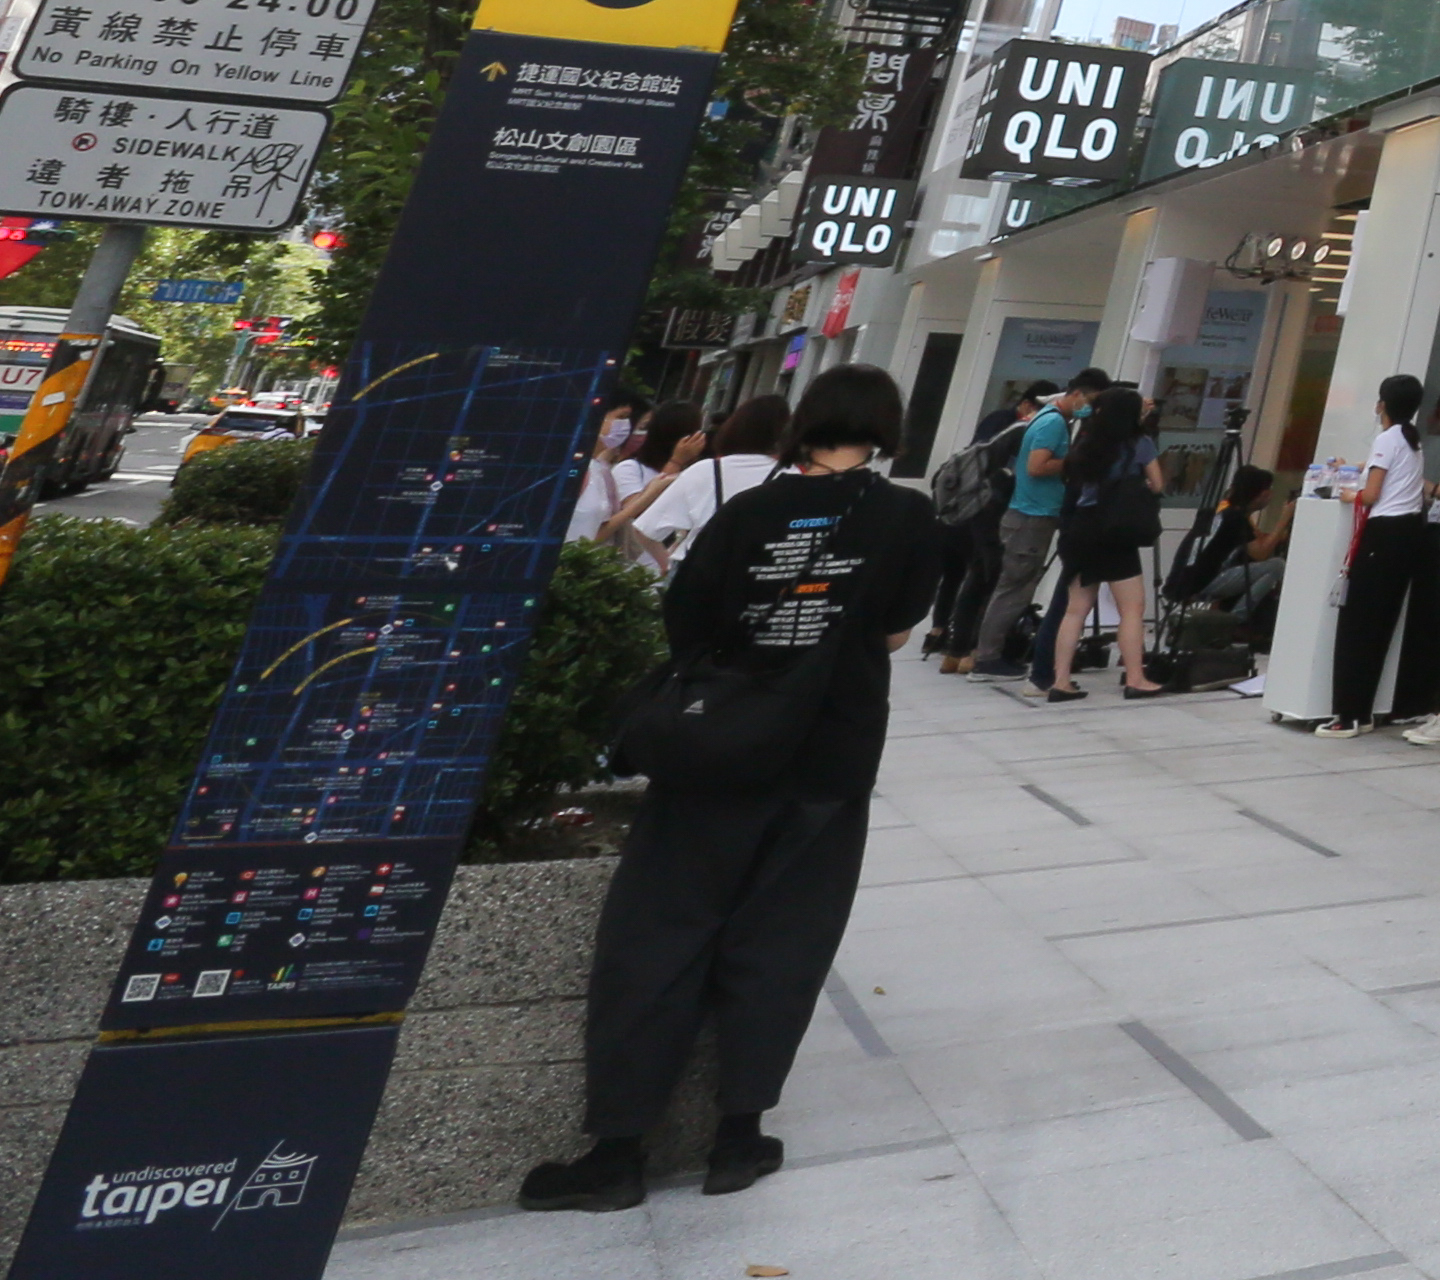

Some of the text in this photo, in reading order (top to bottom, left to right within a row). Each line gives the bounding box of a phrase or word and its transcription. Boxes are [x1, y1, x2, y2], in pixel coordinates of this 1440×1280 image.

[43, 4, 351, 64] 黃線禁止停車
[31, 45, 335, 90] No Parking On Yellow Line
[515, 61, 683, 96] 捷運國父紀念館站
[1018, 56, 1124, 110] UNI
[112, 136, 240, 164] SIDEWALK
[492, 126, 641, 157] 松山文創園區
[1003, 110, 1119, 165] QLO
[25, 156, 254, 200] 違者拖吊
[37, 189, 227, 221] TOW-AWAY ZONE
[823, 184, 898, 219] UNI
[811, 220, 893, 257] QLO
[113, 1157, 238, 1185] undiscovered
